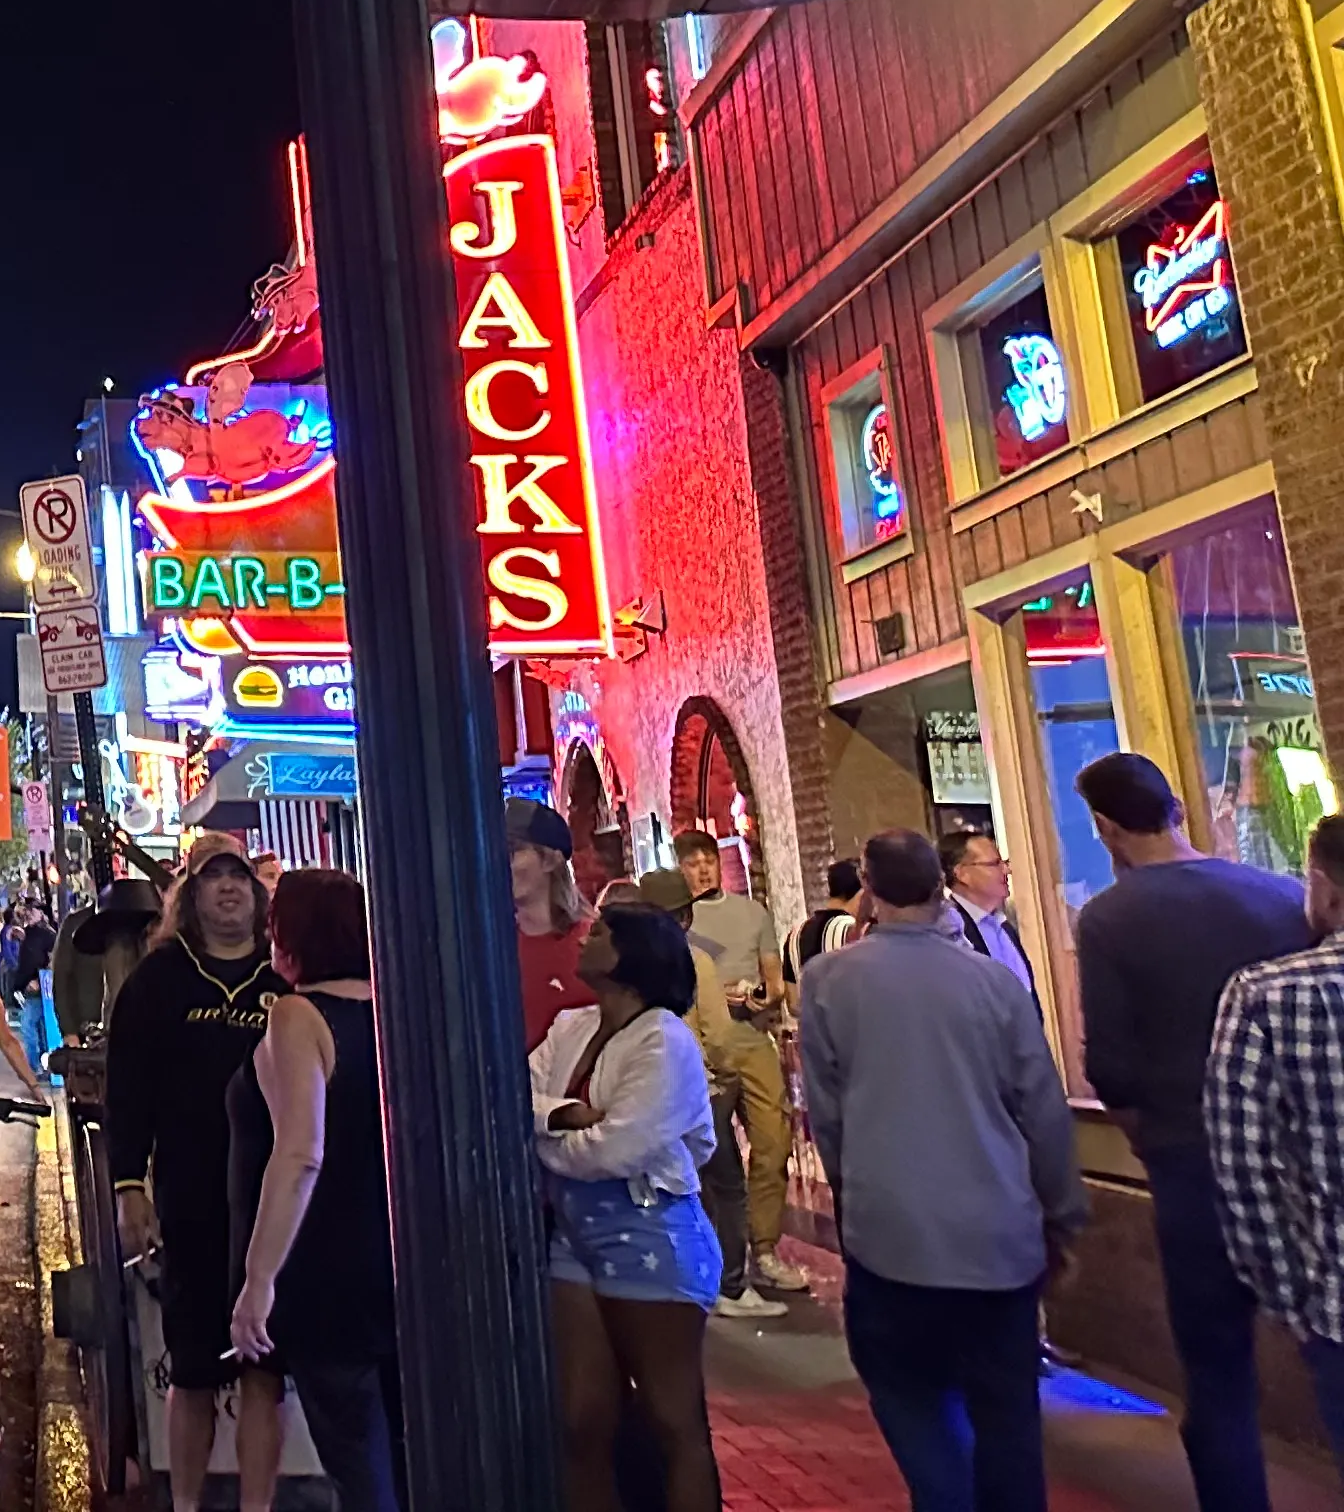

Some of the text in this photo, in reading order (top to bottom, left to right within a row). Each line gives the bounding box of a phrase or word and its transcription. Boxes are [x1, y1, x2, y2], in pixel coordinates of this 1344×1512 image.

[450, 180, 584, 632] JACKS
[39, 544, 81, 566] LOADING
[152, 555, 348, 609] BAR-B-
